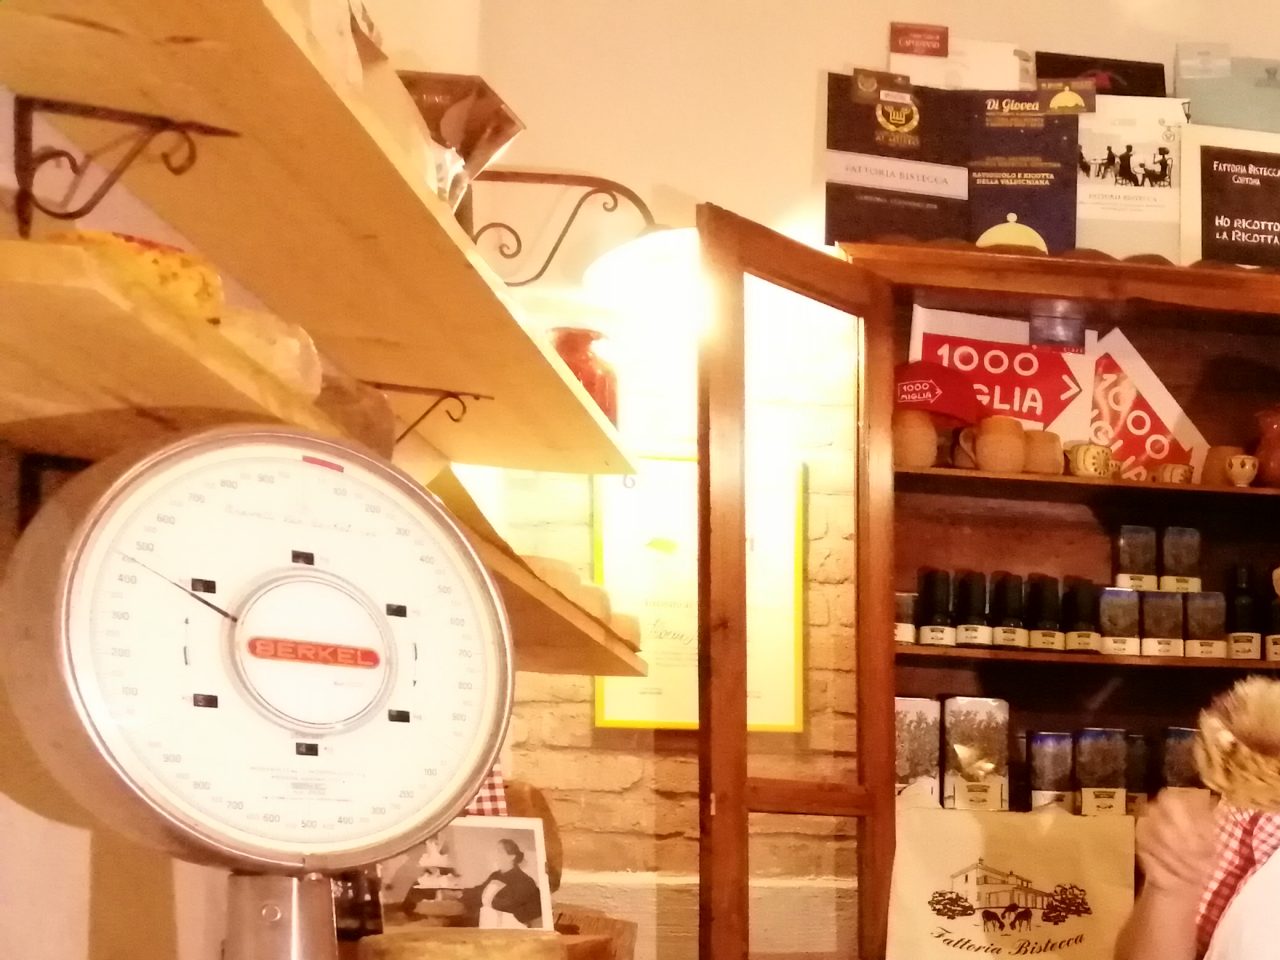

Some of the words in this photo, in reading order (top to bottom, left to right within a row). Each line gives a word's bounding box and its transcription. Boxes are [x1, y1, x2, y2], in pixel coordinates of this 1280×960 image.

[1213, 161, 1247, 174] FATTORIA
[1215, 215, 1231, 227] HO
[1233, 218, 1280, 232] RICOTTO
[1215, 231, 1229, 241] LA
[1231, 230, 1280, 246] RICOTTA
[937, 343, 1039, 377] 1000
[902, 382, 930, 392] 1000
[900, 391, 932, 401] MIGLIA
[972, 383, 1044, 416] GLIA
[1095, 373, 1170, 460] 1000
[333, 487, 348, 497] 100
[135, 540, 155, 553] 500
[117, 573, 138, 585] 400
[254, 639, 374, 666] BERKEL
[423, 767, 438, 777] 100
[226, 800, 244, 811] 700
[262, 814, 281, 824] 600
[301, 819, 318, 829] 500
[336, 815, 354, 826] 400
[929, 926, 1002, 956] Fattoria
[1008, 932, 1085, 957] Bistecca
